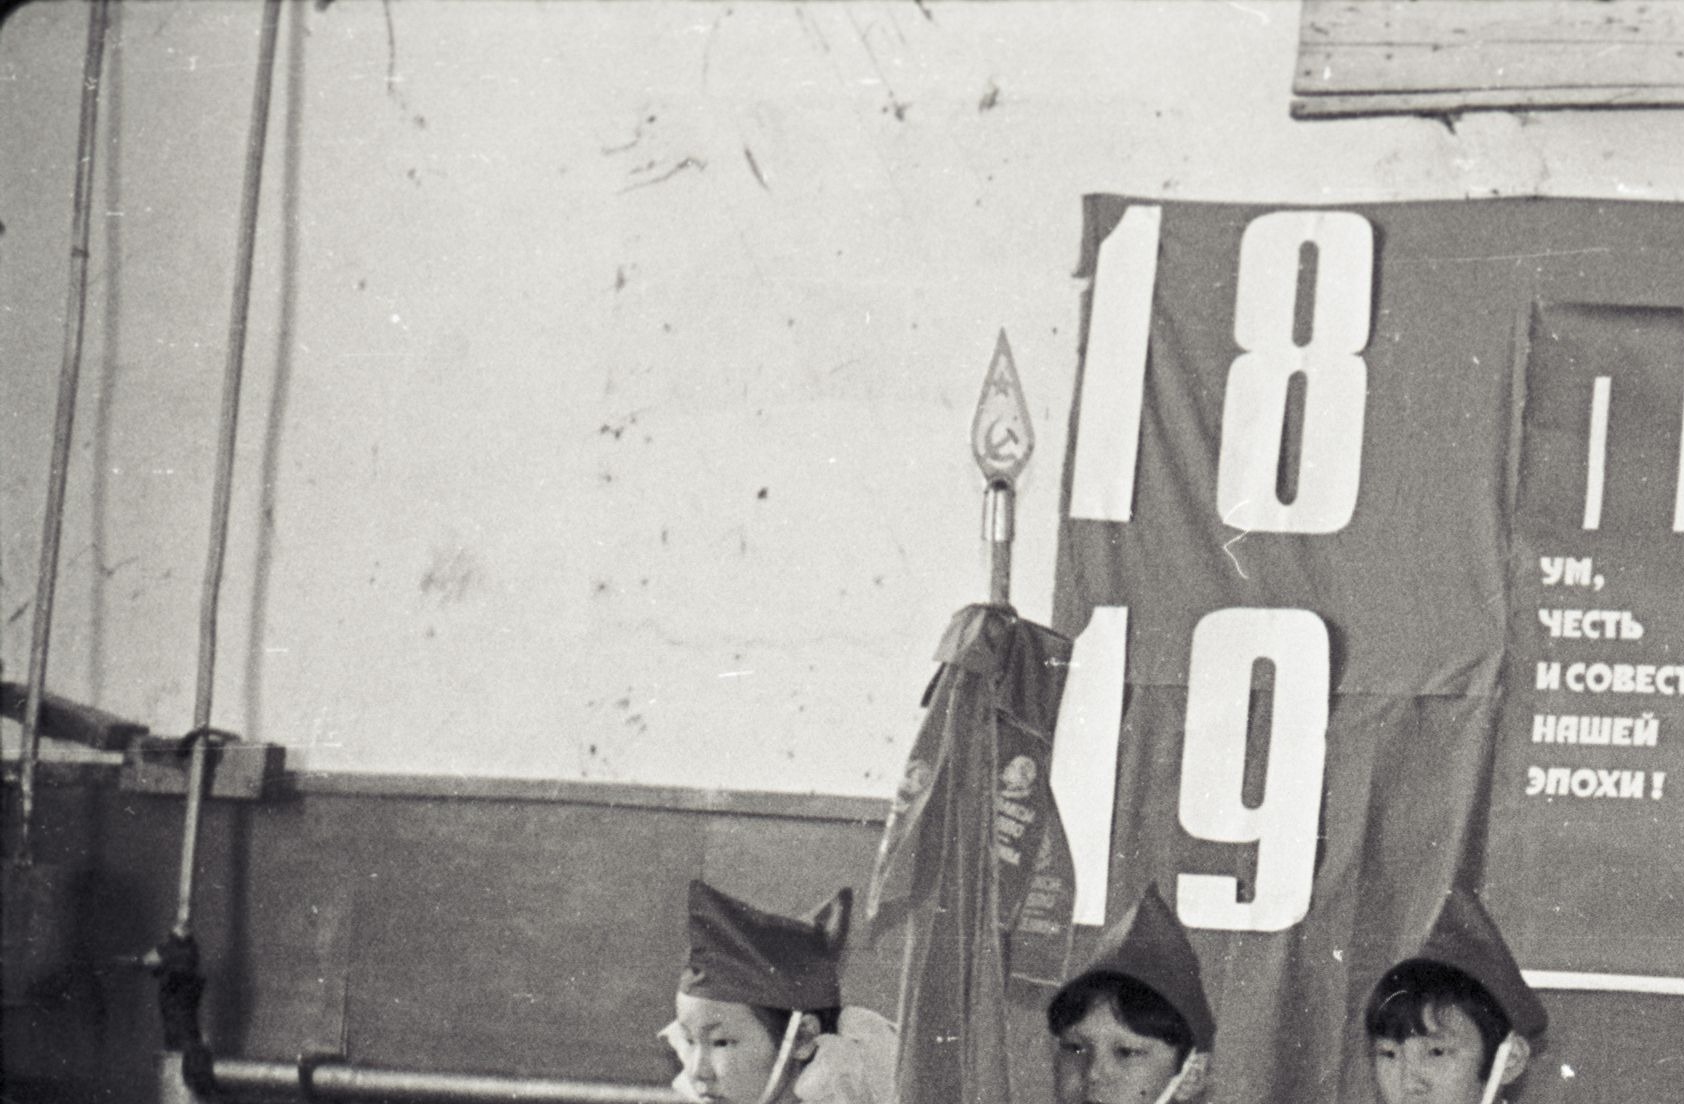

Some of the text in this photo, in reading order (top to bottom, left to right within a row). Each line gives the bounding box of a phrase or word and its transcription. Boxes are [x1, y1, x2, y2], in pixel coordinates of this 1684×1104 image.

[1069, 205, 1374, 534] 18
[1540, 556, 1605, 591] УМ,
[1537, 608, 1644, 640] ЧЕСТЬ
[1535, 661, 1561, 690] И
[1531, 711, 1660, 747] НАШЕЙ
[1049, 606, 1330, 932] 19
